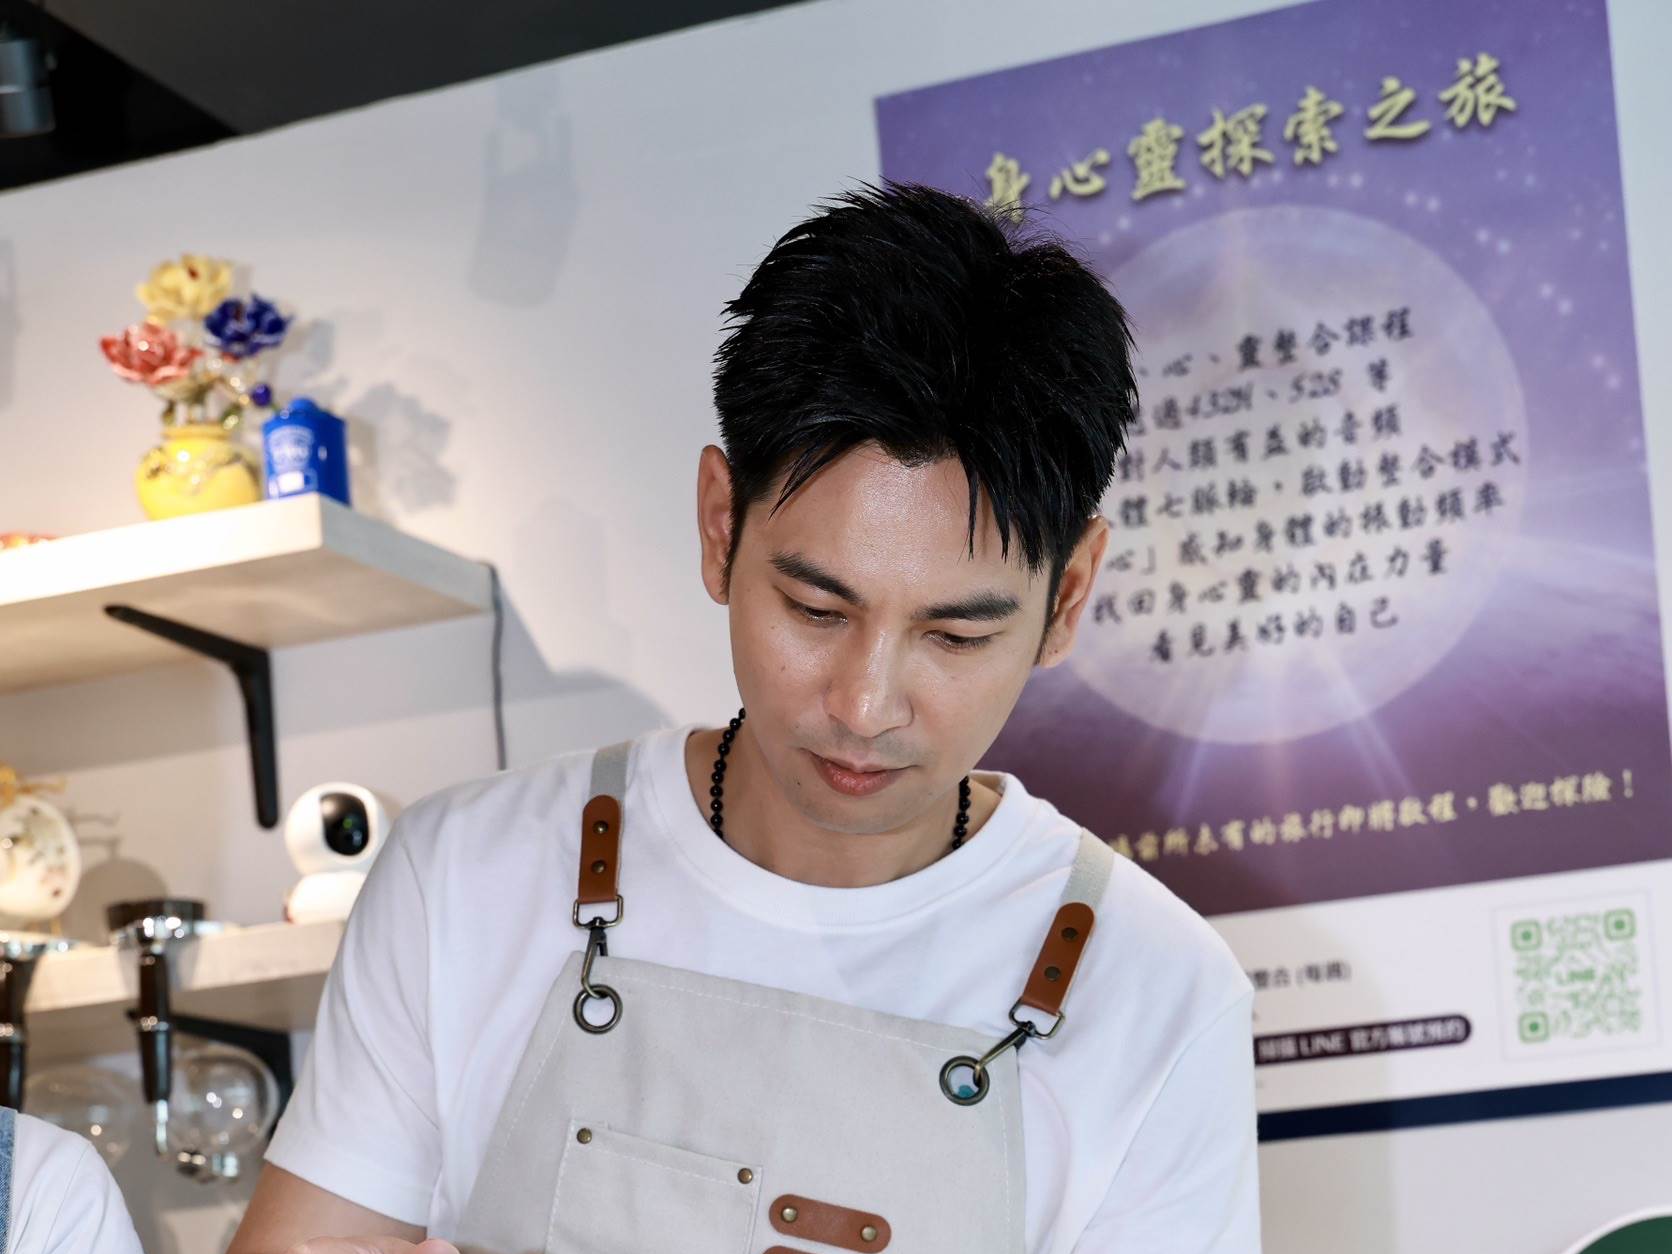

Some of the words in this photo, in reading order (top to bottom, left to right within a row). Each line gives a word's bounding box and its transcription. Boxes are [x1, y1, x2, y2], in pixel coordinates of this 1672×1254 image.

[986, 52, 1517, 223] 身心靈探索之旅
[1299, 1031, 1343, 1056] LINE
